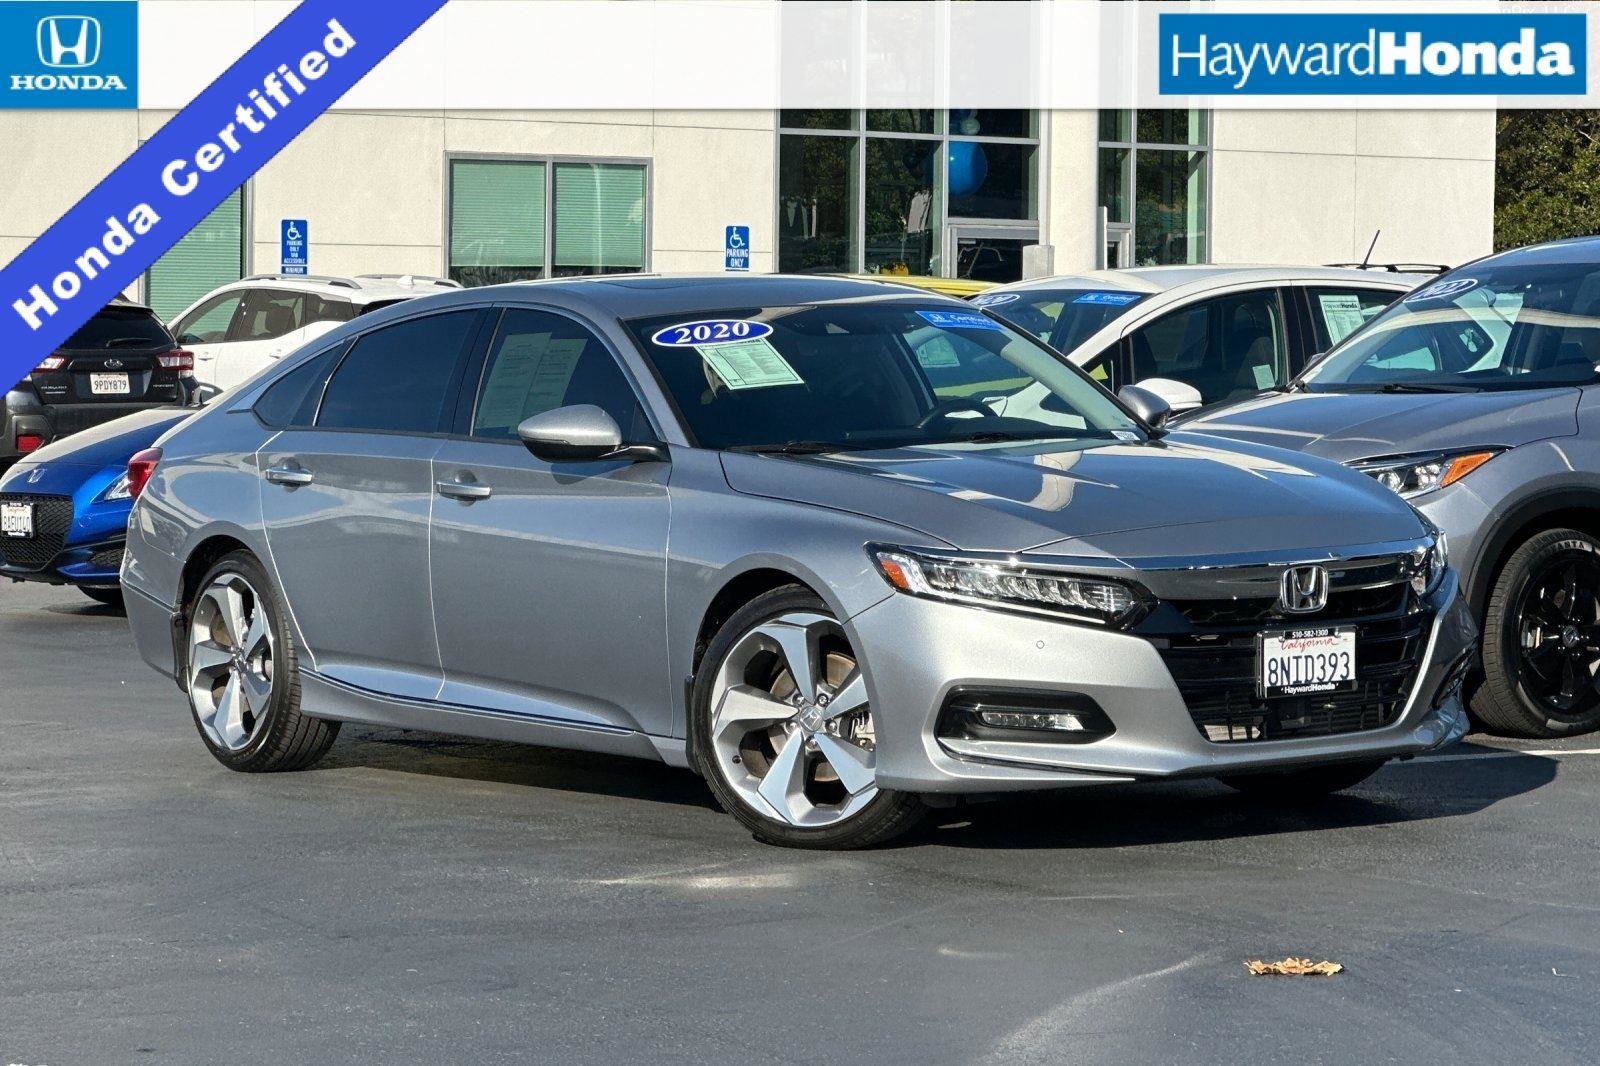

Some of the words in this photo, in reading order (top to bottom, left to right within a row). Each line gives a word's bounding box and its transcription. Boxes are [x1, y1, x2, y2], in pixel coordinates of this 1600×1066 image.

[726, 248, 749, 258] PARKING
[730, 257, 744, 268] ONLY
[674, 321, 750, 344] 2020
[1268, 651, 1350, 687] 8NID393
